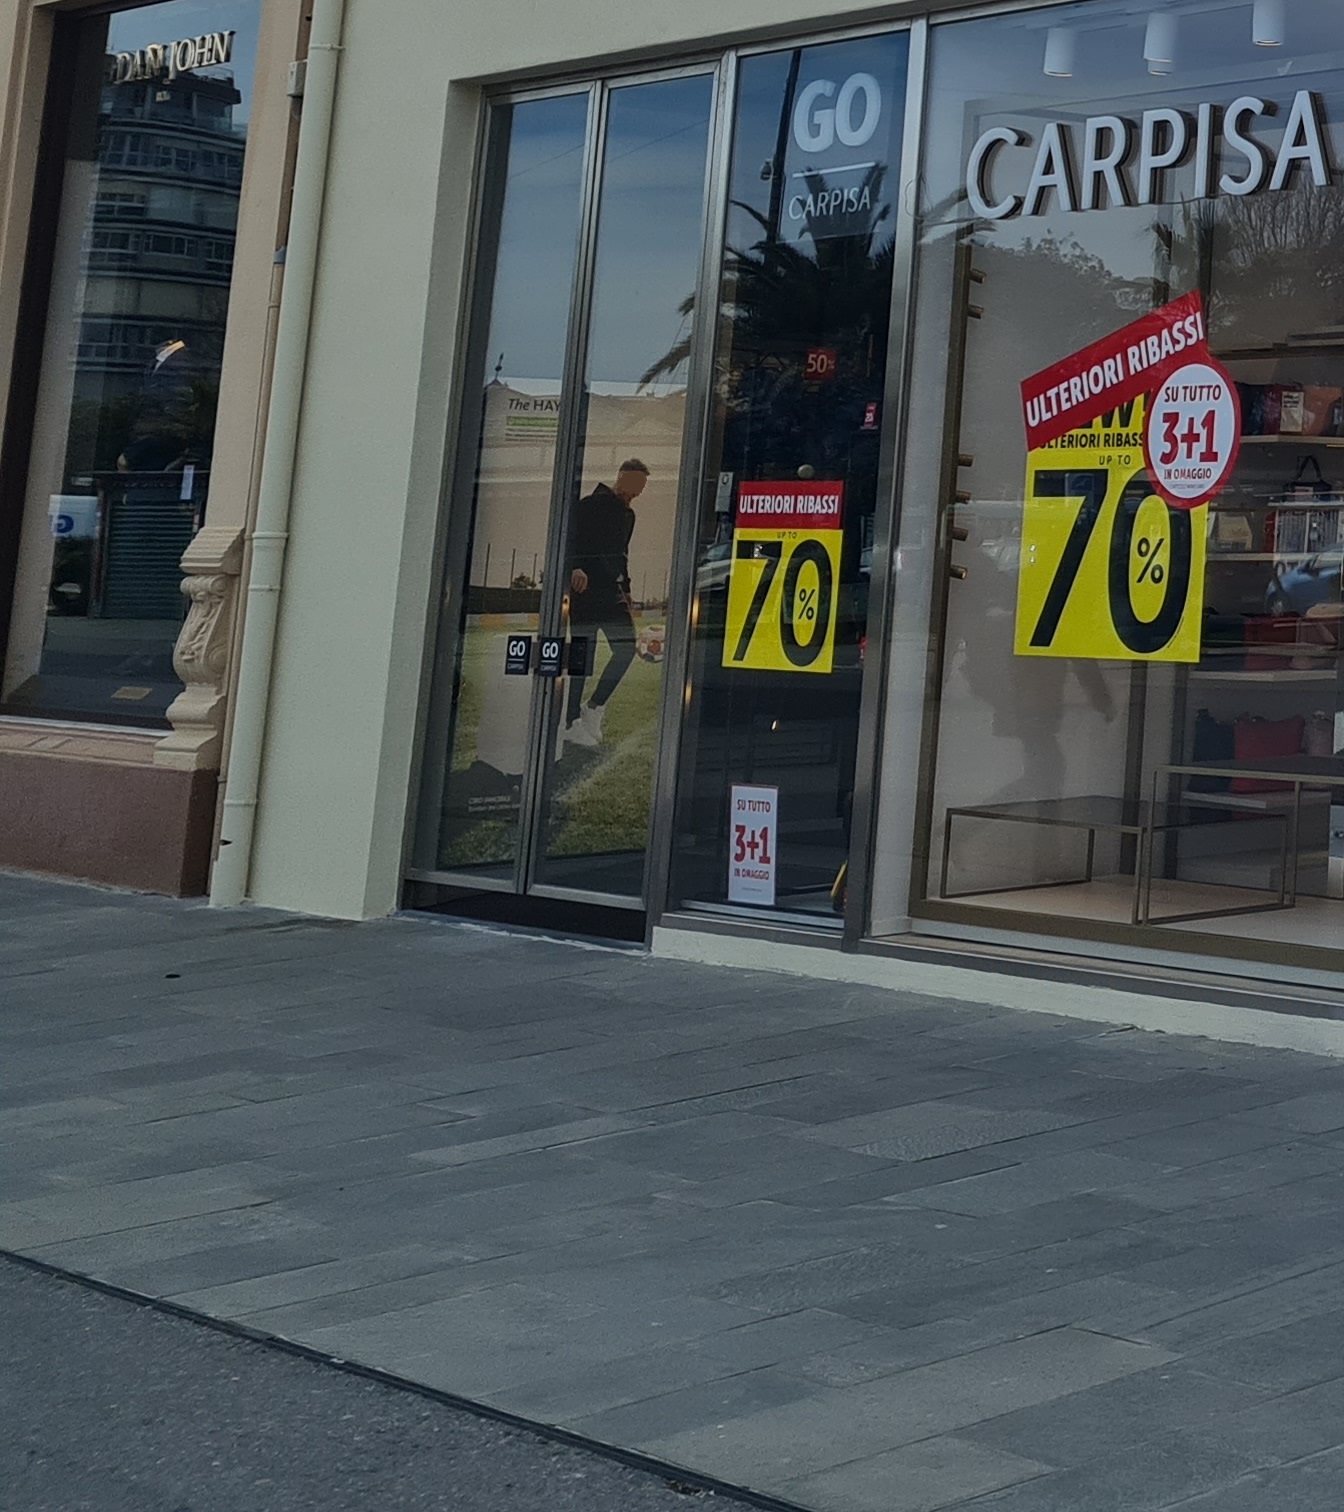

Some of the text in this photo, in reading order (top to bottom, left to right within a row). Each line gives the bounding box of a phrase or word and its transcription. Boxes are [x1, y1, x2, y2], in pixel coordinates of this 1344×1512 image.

[114, 30, 236, 85] DAN JOHN
[792, 72, 882, 153] GO
[966, 89, 1332, 220] CARPISA
[787, 185, 872, 221] CARPISA
[1025, 352, 1125, 429] ULTERIORI
[1126, 311, 1205, 376] RIBASSI
[1163, 384, 1222, 403] SU TUTTO
[509, 397, 530, 411] The
[1159, 409, 1219, 466] 3+1
[1099, 454, 1131, 466] UP TO
[1163, 467, 1212, 480] IN OMAGGIO
[739, 494, 839, 514] ULTERIORI RIBASSI
[508, 640, 526, 656] GO
[542, 642, 559, 658] GO
[736, 799, 771, 813] SU TUTTO
[734, 824, 772, 865] 3+1
[742, 868, 770, 880] OMAGGIO
